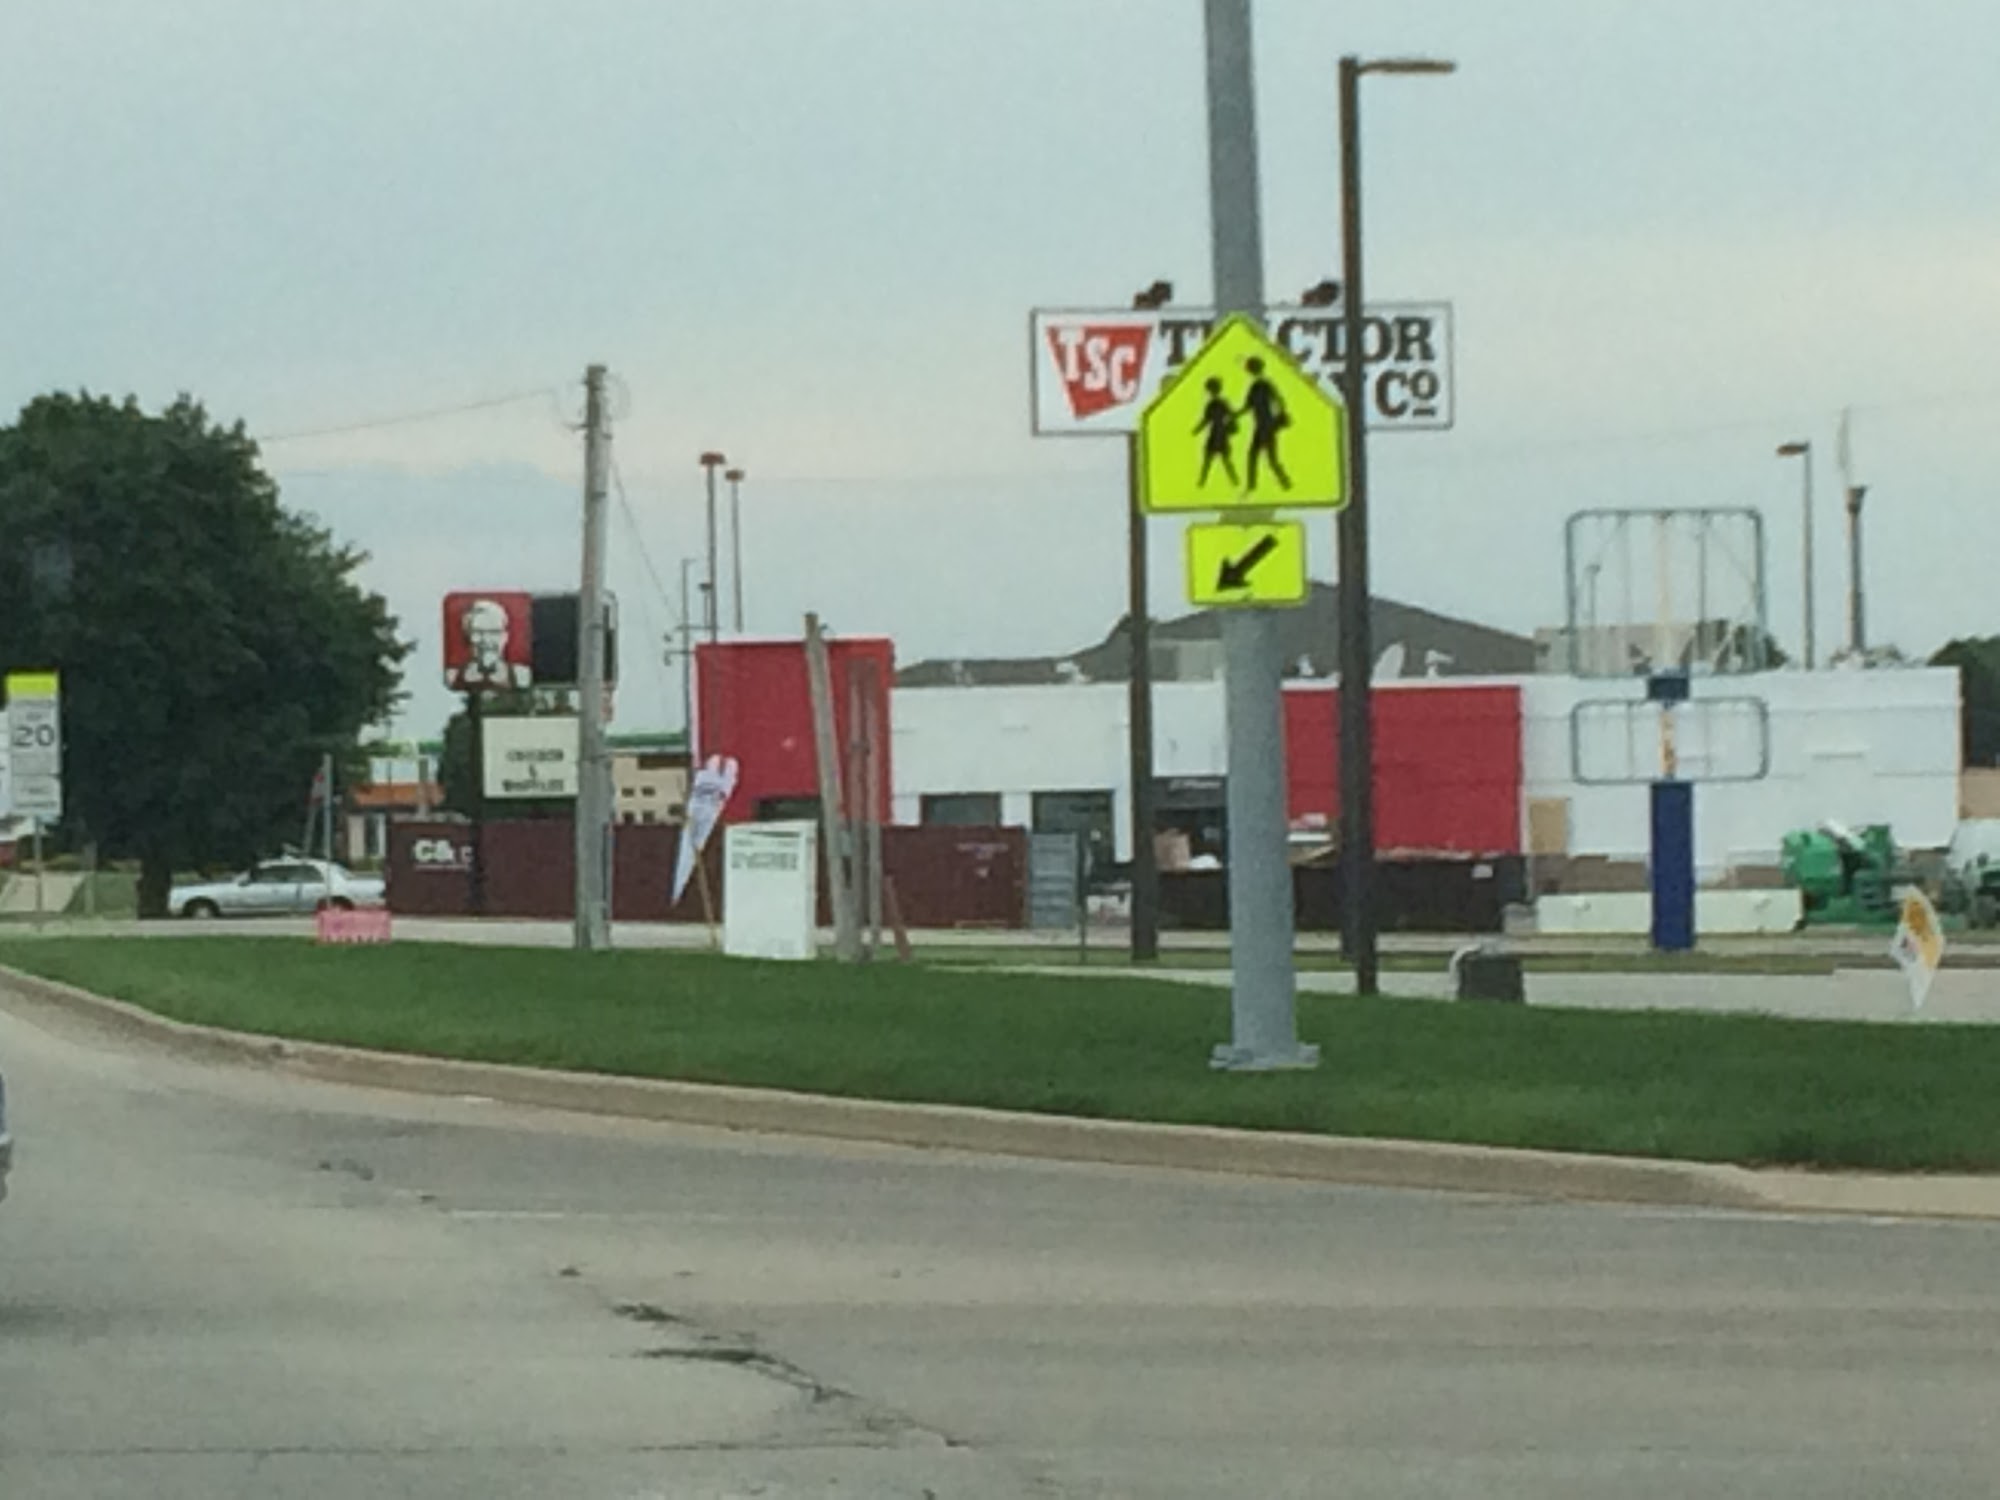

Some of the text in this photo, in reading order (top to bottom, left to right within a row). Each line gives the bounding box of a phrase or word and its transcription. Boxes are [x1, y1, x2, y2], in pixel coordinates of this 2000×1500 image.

[1056, 327, 1138, 401] TSC
[1160, 316, 1436, 364] TCTOR
[13, 723, 55, 748] 20
